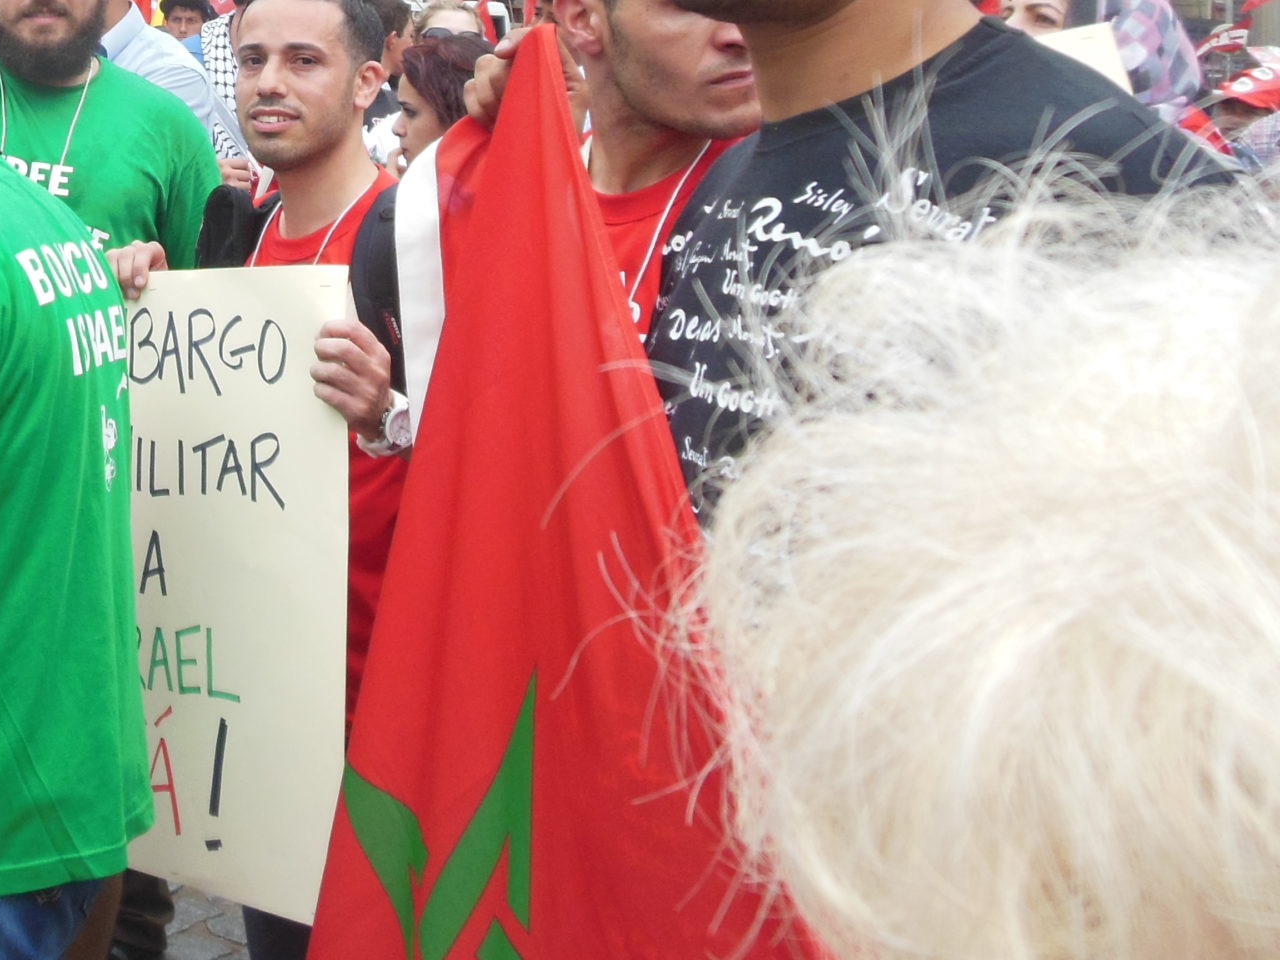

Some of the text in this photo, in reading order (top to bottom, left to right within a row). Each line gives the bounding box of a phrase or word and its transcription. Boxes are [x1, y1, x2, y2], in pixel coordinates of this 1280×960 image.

[793, 181, 856, 225] Sisley
[125, 306, 287, 396] BARGO
[130, 430, 286, 511] ILITAR
[139, 529, 168, 597] A
